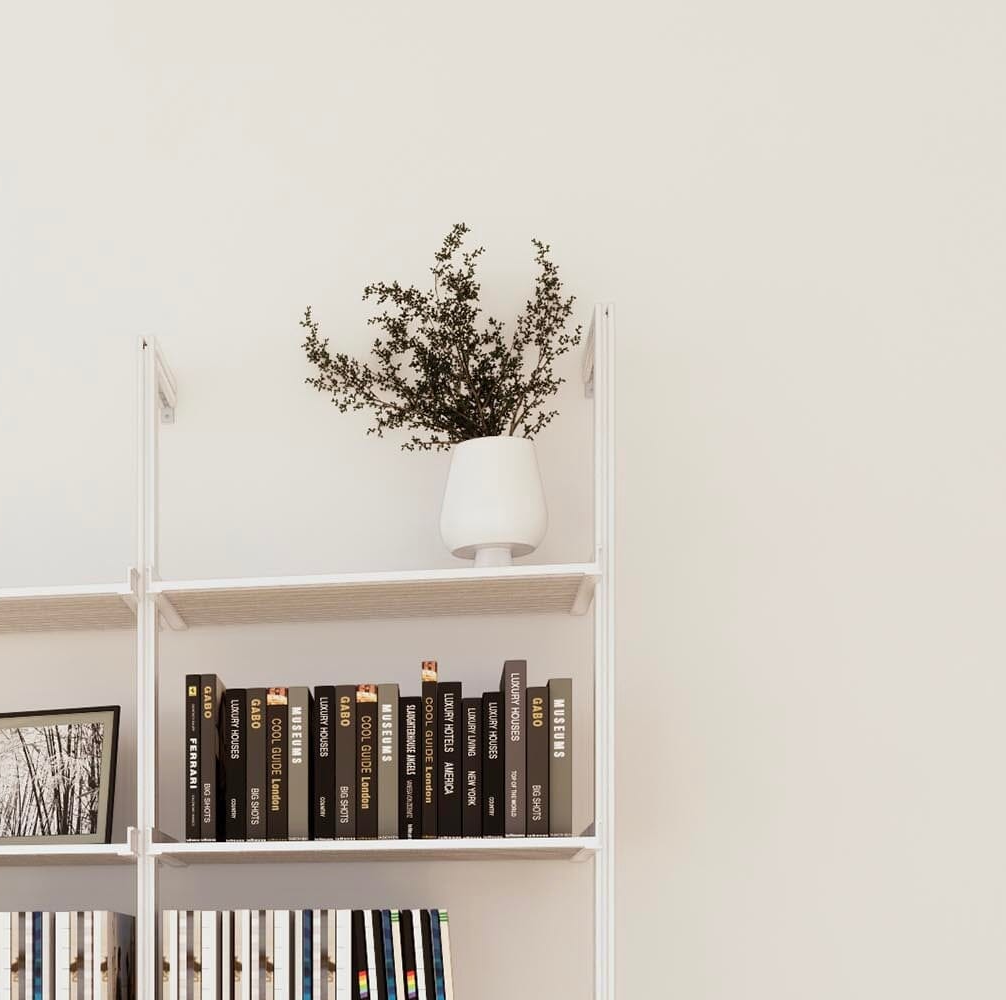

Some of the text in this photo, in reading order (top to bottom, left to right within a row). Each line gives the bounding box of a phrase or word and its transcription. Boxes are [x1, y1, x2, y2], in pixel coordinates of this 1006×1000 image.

[204, 686, 212, 719] GABO
[231, 699, 239, 759] LUXURY HOUSES
[251, 698, 261, 729] GABO
[320, 697, 328, 758] LUXURY HOUSES
[340, 696, 350, 727] GABO
[489, 702, 497, 760] LUXURY HOUSES
[511, 673, 520, 742] LUXURY HOUSES
[532, 697, 543, 727] GABO
[554, 698, 565, 758] MUSEUMS
[292, 706, 302, 764] MUSEUMS
[382, 704, 392, 762] MUSEUMS
[406, 704, 416, 775] SLAUGHTERHOUSE ANGELS
[425, 697, 434, 803] COOL GUIDE London
[444, 693, 454, 795] LUXURY HOTELS AMERICA
[467, 707, 476, 757] LUXURY LIVING
[189, 738, 198, 789] FERRARI
[271, 718, 282, 811] COOL GUIDE London
[361, 715, 372, 809] COOL GUIDE London
[467, 770, 476, 806] NEW YORK
[203, 783, 211, 824] BIG SHOTS
[251, 788, 259, 825] BIG SHOTS
[340, 786, 349, 824] BIG SHOTS
[532, 785, 541, 821] BIG SHOTS
